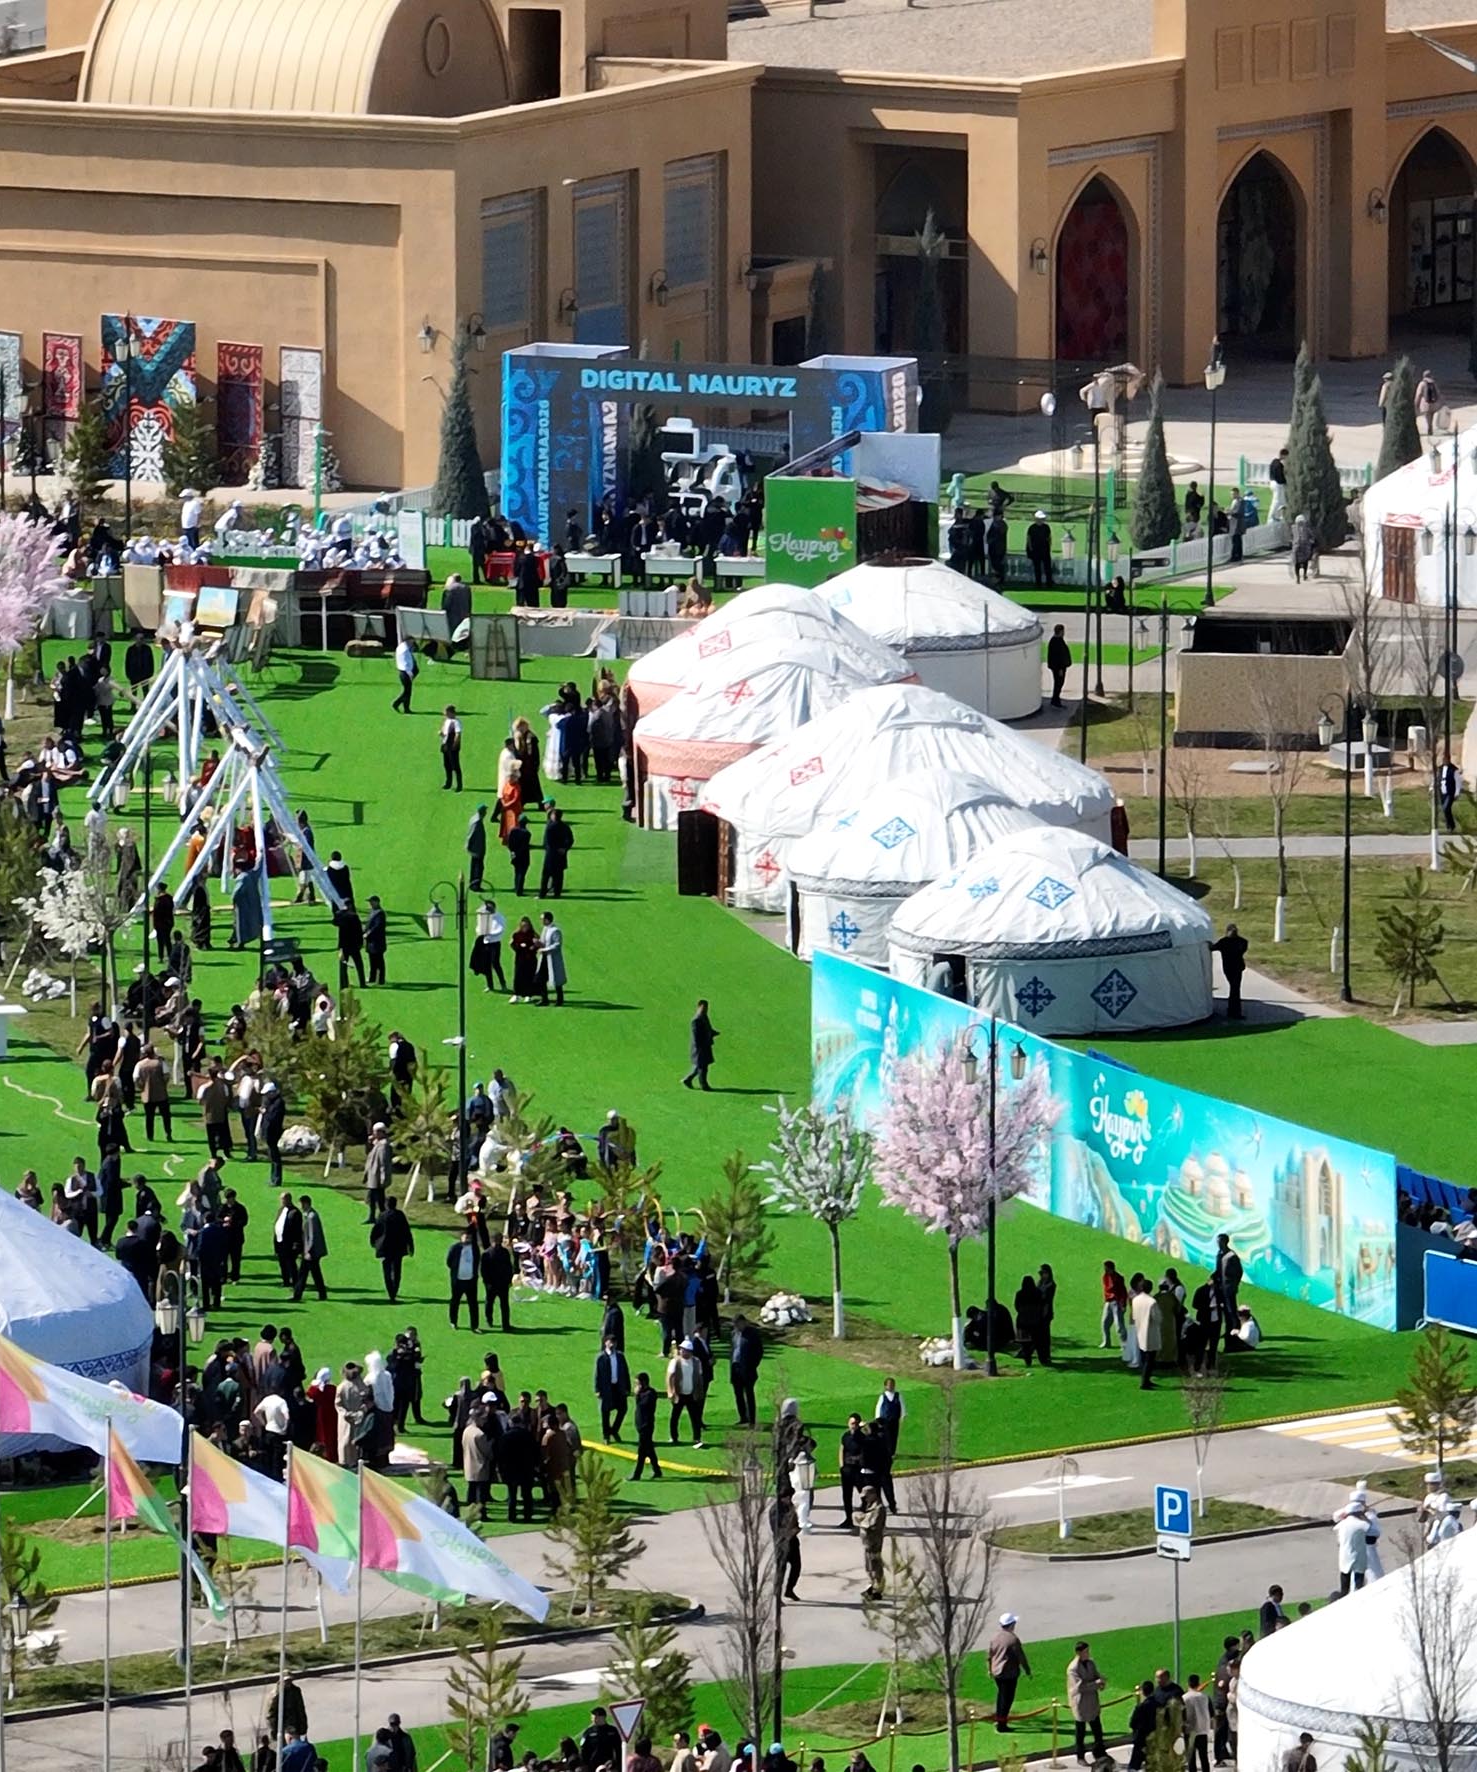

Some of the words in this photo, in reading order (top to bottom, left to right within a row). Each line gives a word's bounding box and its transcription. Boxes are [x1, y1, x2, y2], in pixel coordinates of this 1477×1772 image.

[581, 368, 682, 392] DIGITAL
[688, 373, 797, 397] NAURYZ
[1162, 1491, 1183, 1528] P
